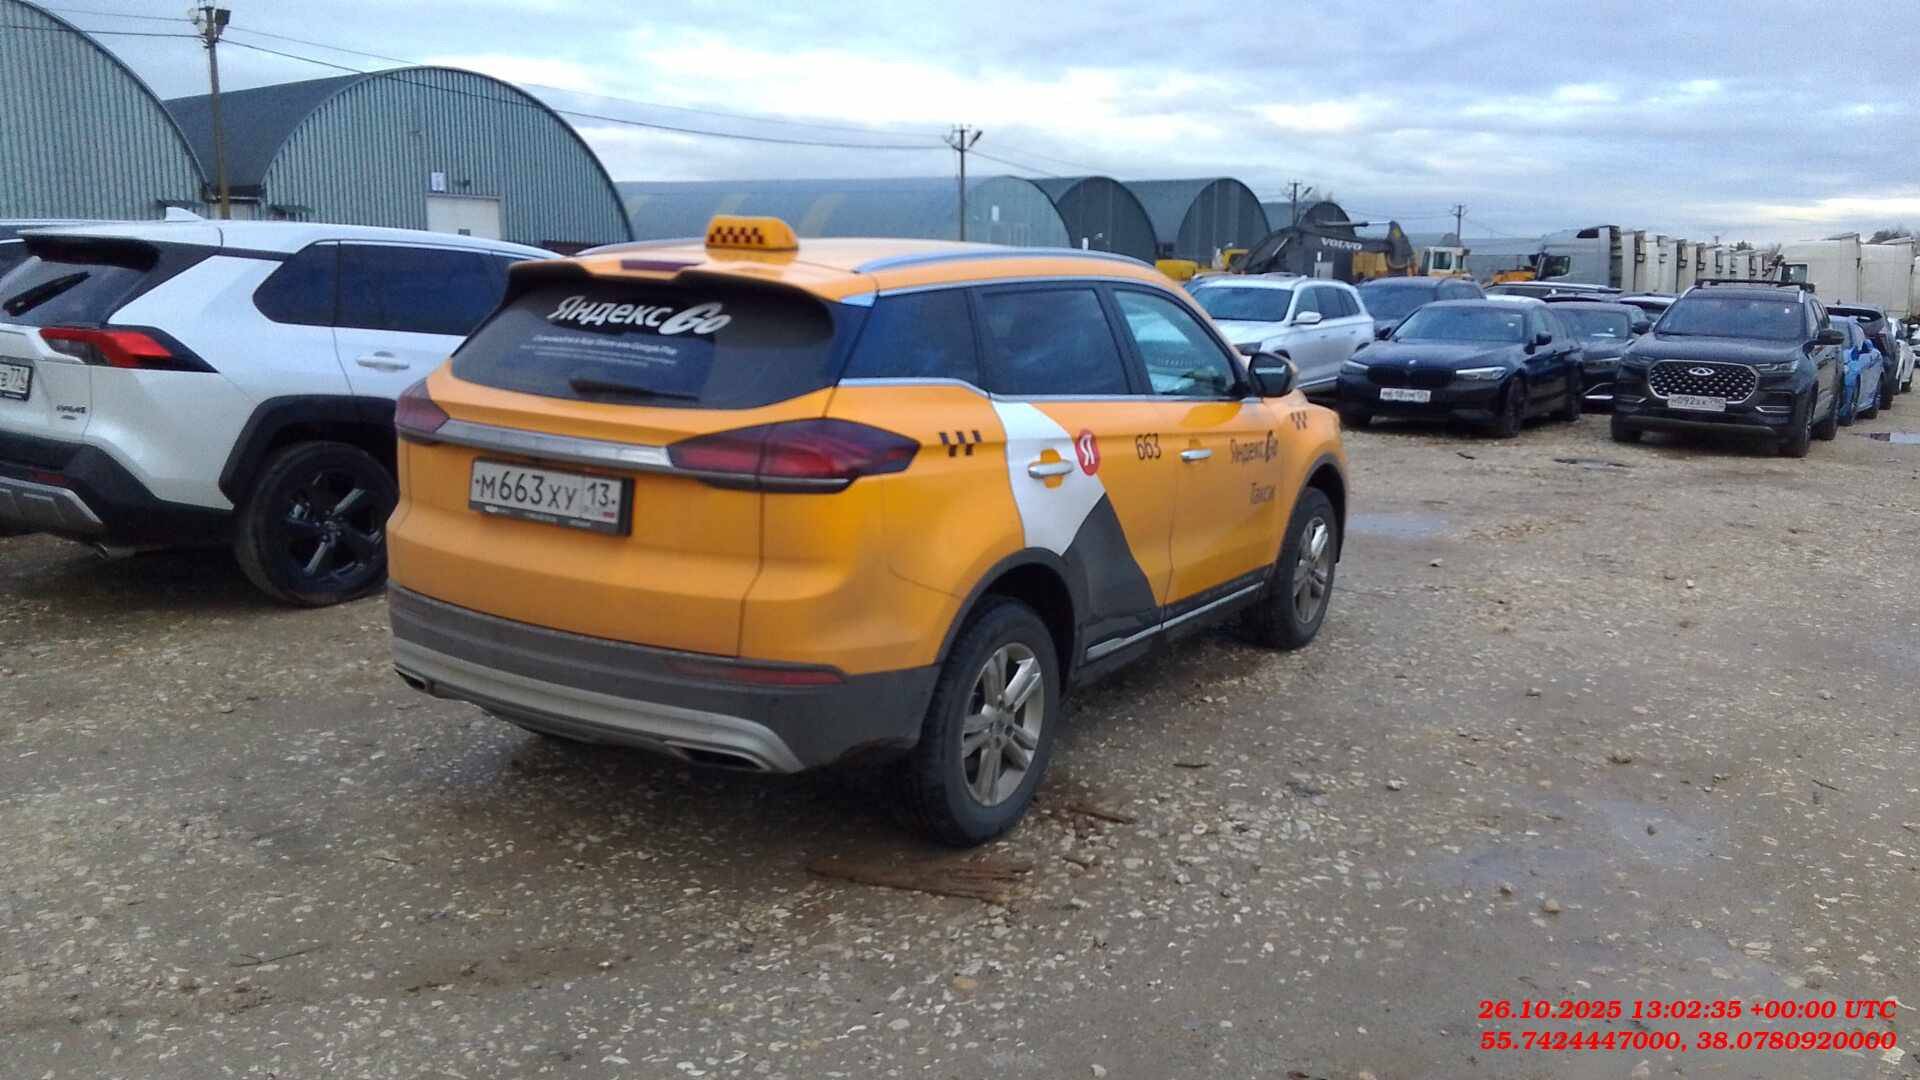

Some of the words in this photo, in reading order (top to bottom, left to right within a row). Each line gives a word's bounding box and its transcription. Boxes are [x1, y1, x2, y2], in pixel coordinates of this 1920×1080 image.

[1321, 237, 1363, 250] VOLVO
[547, 296, 673, 327] Яндекс
[658, 302, 732, 335] Go
[1080, 434, 1095, 466] Я
[1135, 433, 1161, 460] 663
[1231, 439, 1265, 464] Яндекс
